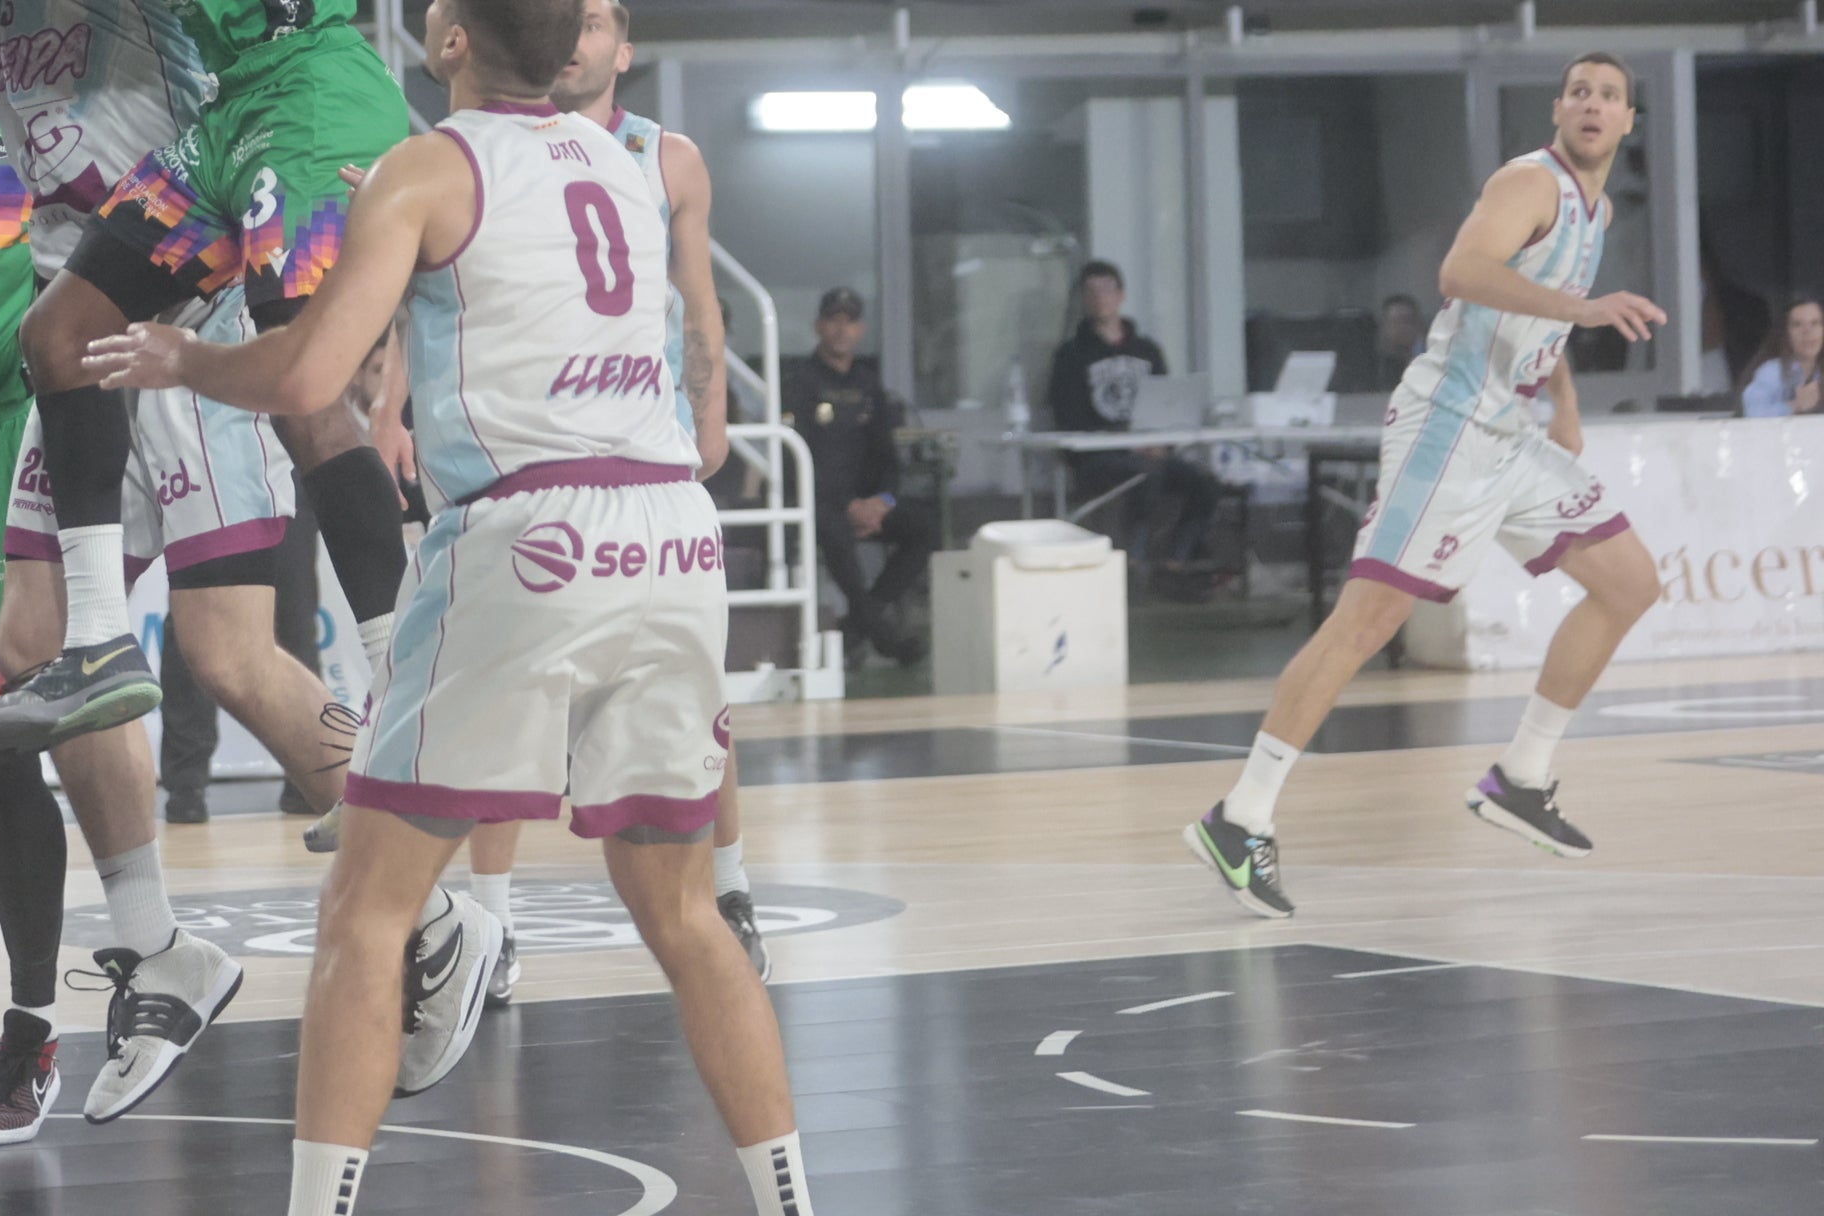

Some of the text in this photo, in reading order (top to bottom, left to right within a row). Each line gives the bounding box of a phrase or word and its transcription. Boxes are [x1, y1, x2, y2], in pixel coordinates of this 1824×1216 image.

[163, 143, 189, 184] OYOTA
[242, 166, 278, 230] 3
[564, 181, 634, 317] 0
[547, 354, 663, 398] LLEIDA
